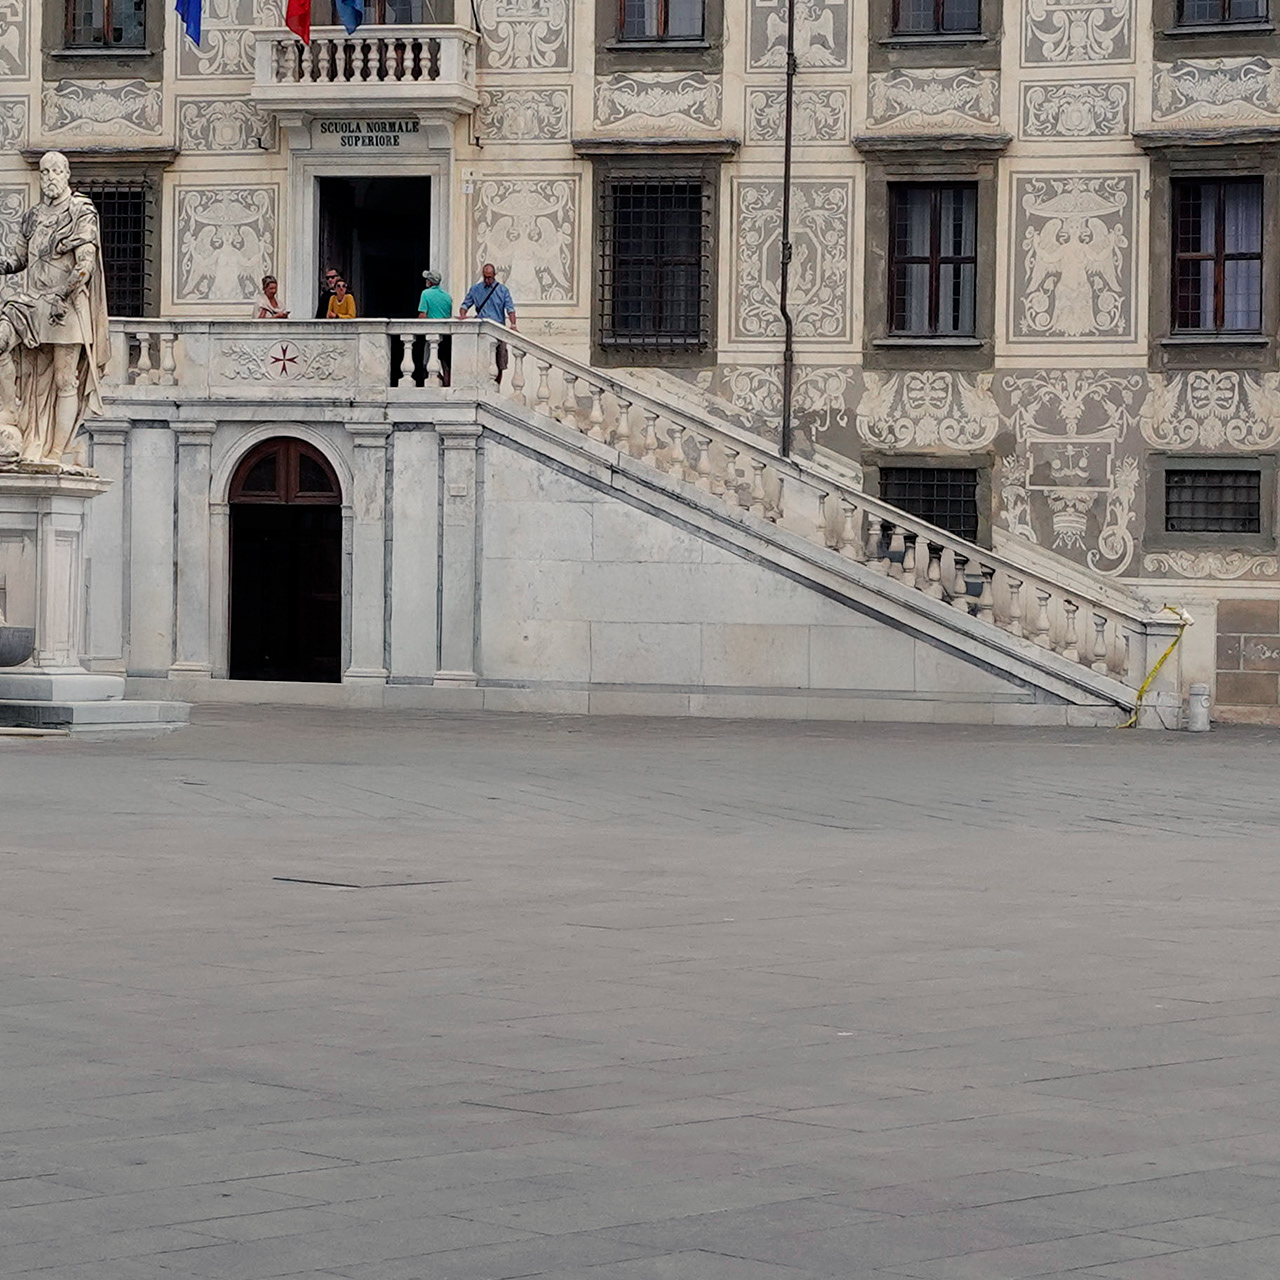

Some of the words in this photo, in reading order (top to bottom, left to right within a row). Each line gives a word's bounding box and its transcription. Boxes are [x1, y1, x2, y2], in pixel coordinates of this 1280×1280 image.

[320, 122, 362, 133] SCUOLA
[366, 121, 419, 133] NORMALE
[340, 135, 400, 147] SUPERIORE
